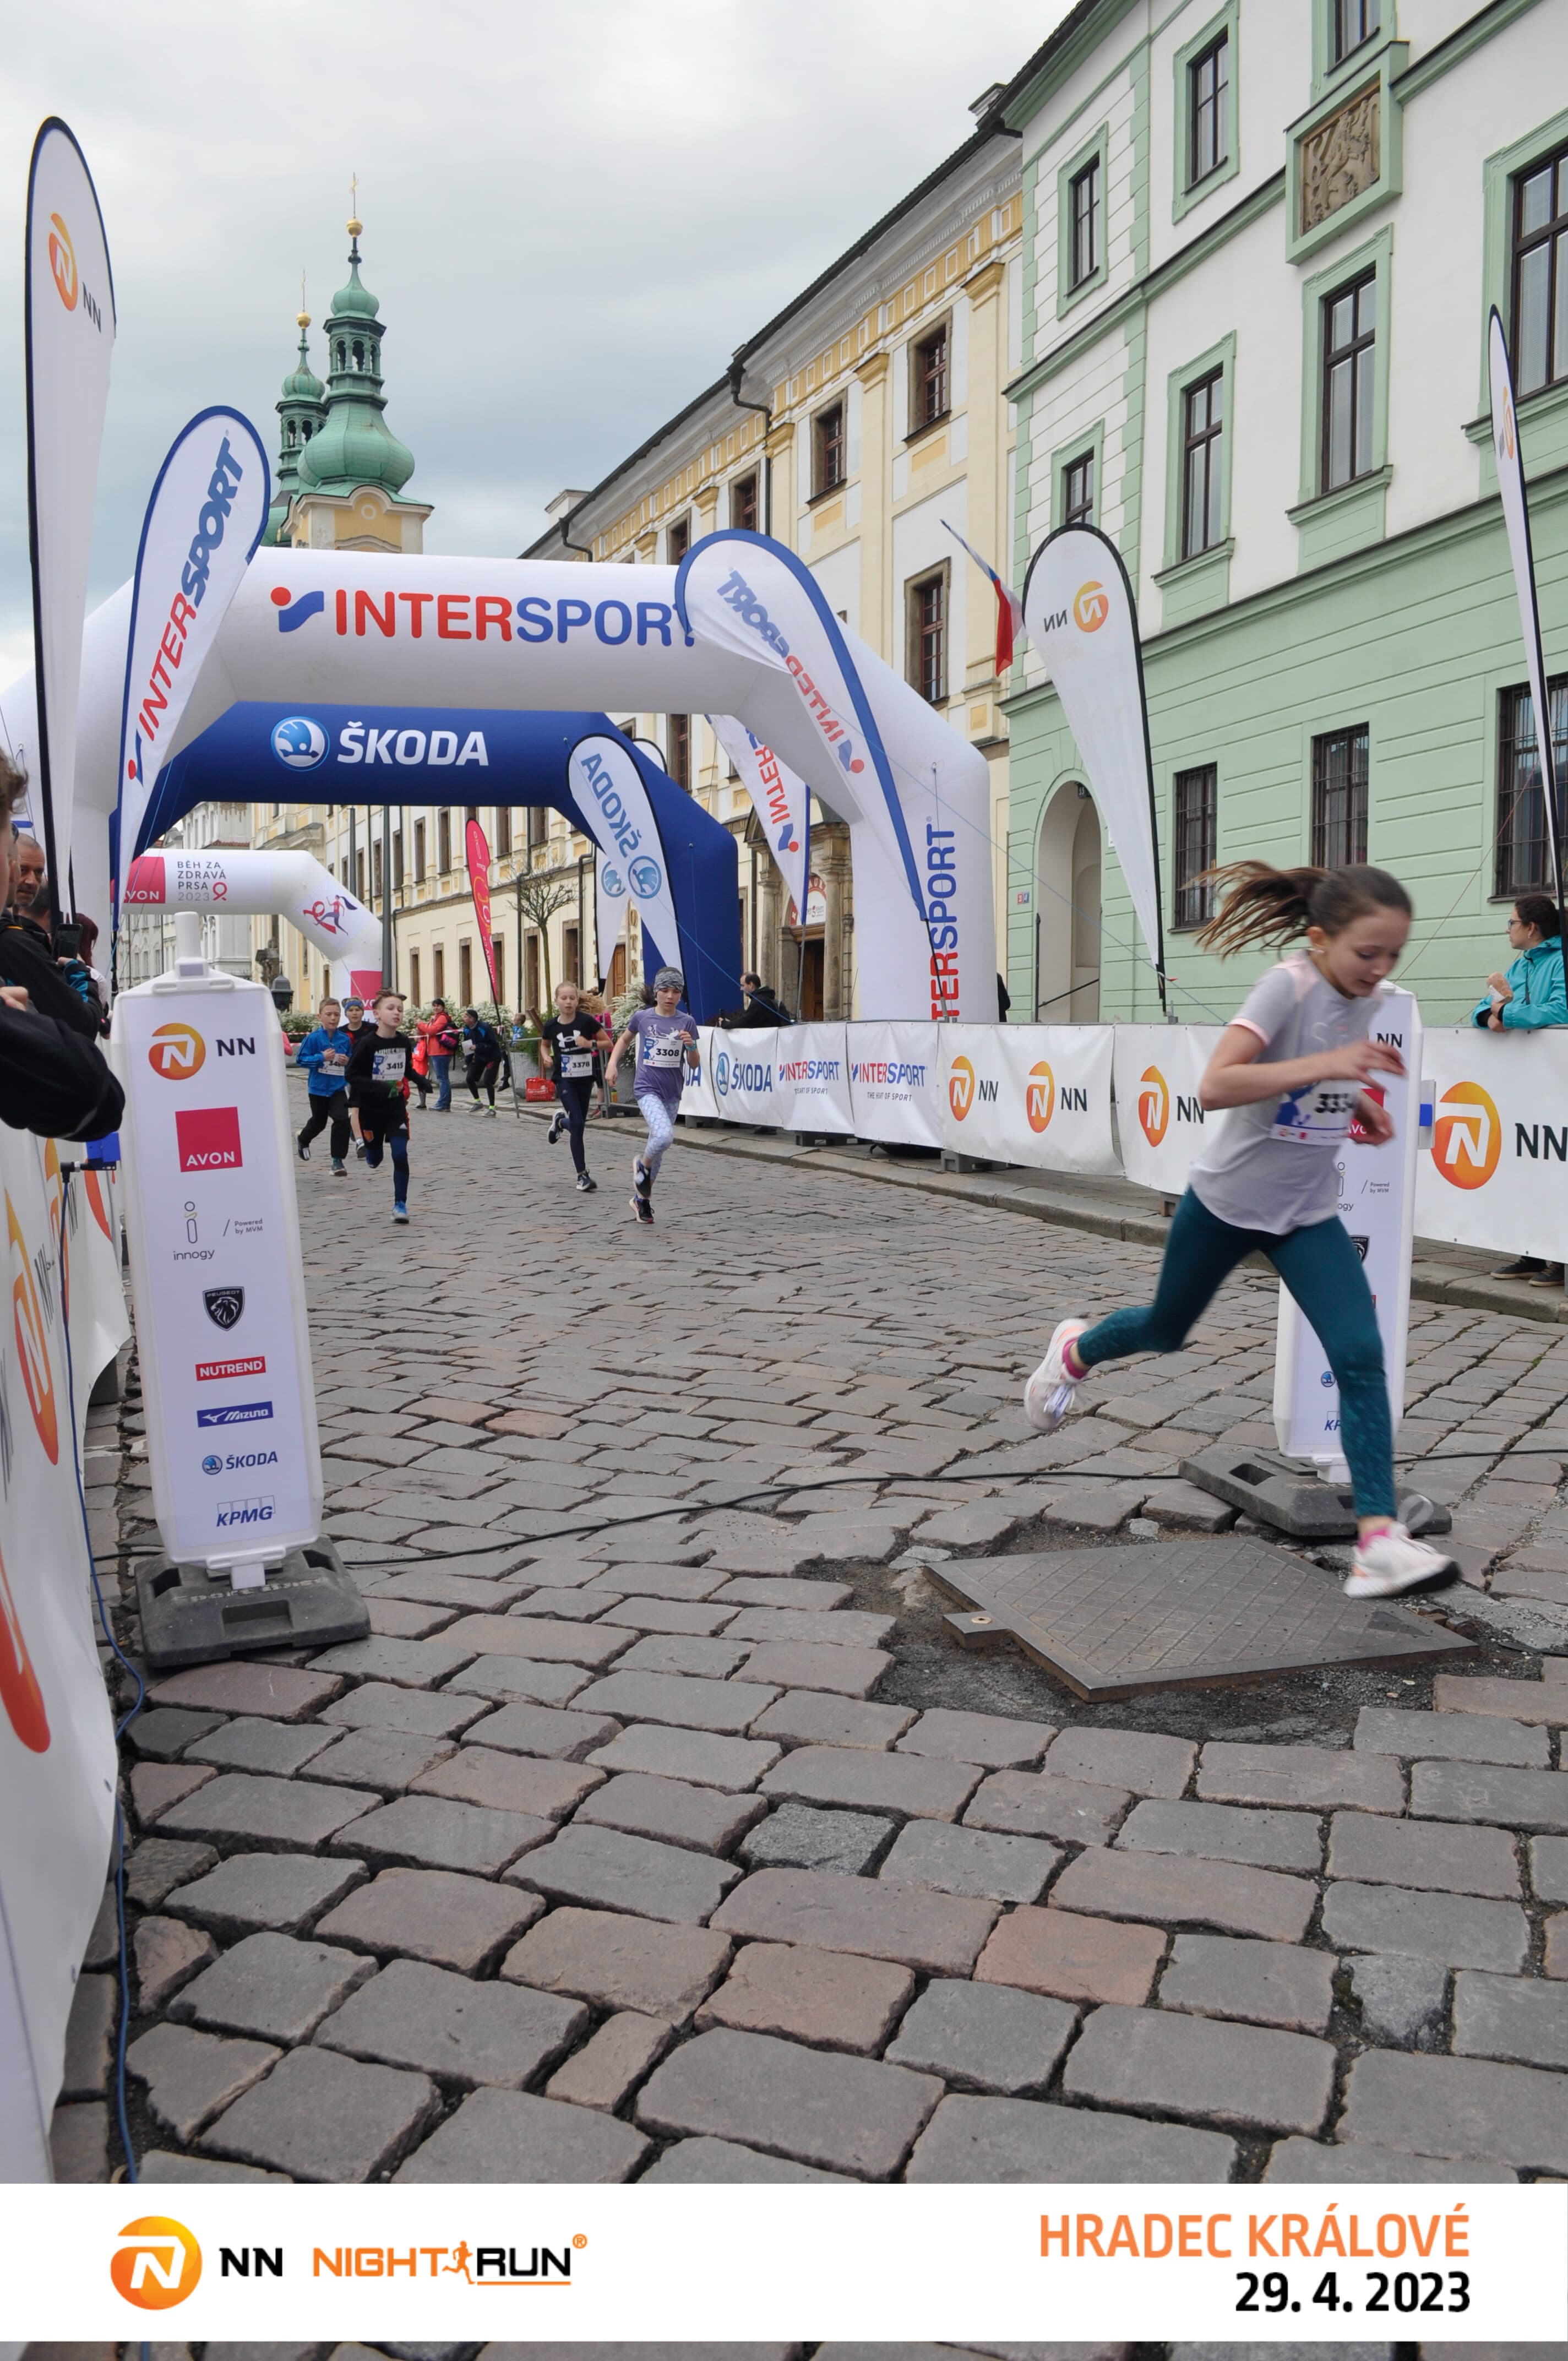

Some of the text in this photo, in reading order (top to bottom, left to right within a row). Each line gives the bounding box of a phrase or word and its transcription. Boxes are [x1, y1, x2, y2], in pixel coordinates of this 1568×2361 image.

[83, 281, 101, 334] NN
[138, 436, 243, 742] INTERSPORT
[336, 720, 489, 766] ŠKODA
[178, 869, 226, 879] ZDRAVÁ
[124, 890, 159, 900] VON
[178, 882, 208, 890] PRSA
[178, 892, 210, 901] 2023
[926, 823, 960, 1020] TERSPORT
[216, 1037, 255, 1057] NN
[1377, 1031, 1402, 1048] NN
[656, 1048, 679, 1057] 3308
[386, 1062, 403, 1070] 3415
[731, 1058, 773, 1092] ŠKODA
[859, 1062, 925, 1087] INTERSPORT
[891, 1093, 912, 1101] SPORT
[978, 1080, 999, 1102] NN
[1061, 1087, 1087, 1112] NN
[1177, 1095, 1205, 1124] NN
[1515, 1123, 1568, 1162] NN
[187, 1151, 235, 1167] AVON
[1337, 1203, 1354, 1211] ogy
[235, 1218, 263, 1227] Powered
[173, 1249, 215, 1260] innogy
[199, 1360, 263, 1377] NUTREND
[226, 1451, 279, 1470] ŠKODA
[216, 1505, 273, 1527] KPMG
